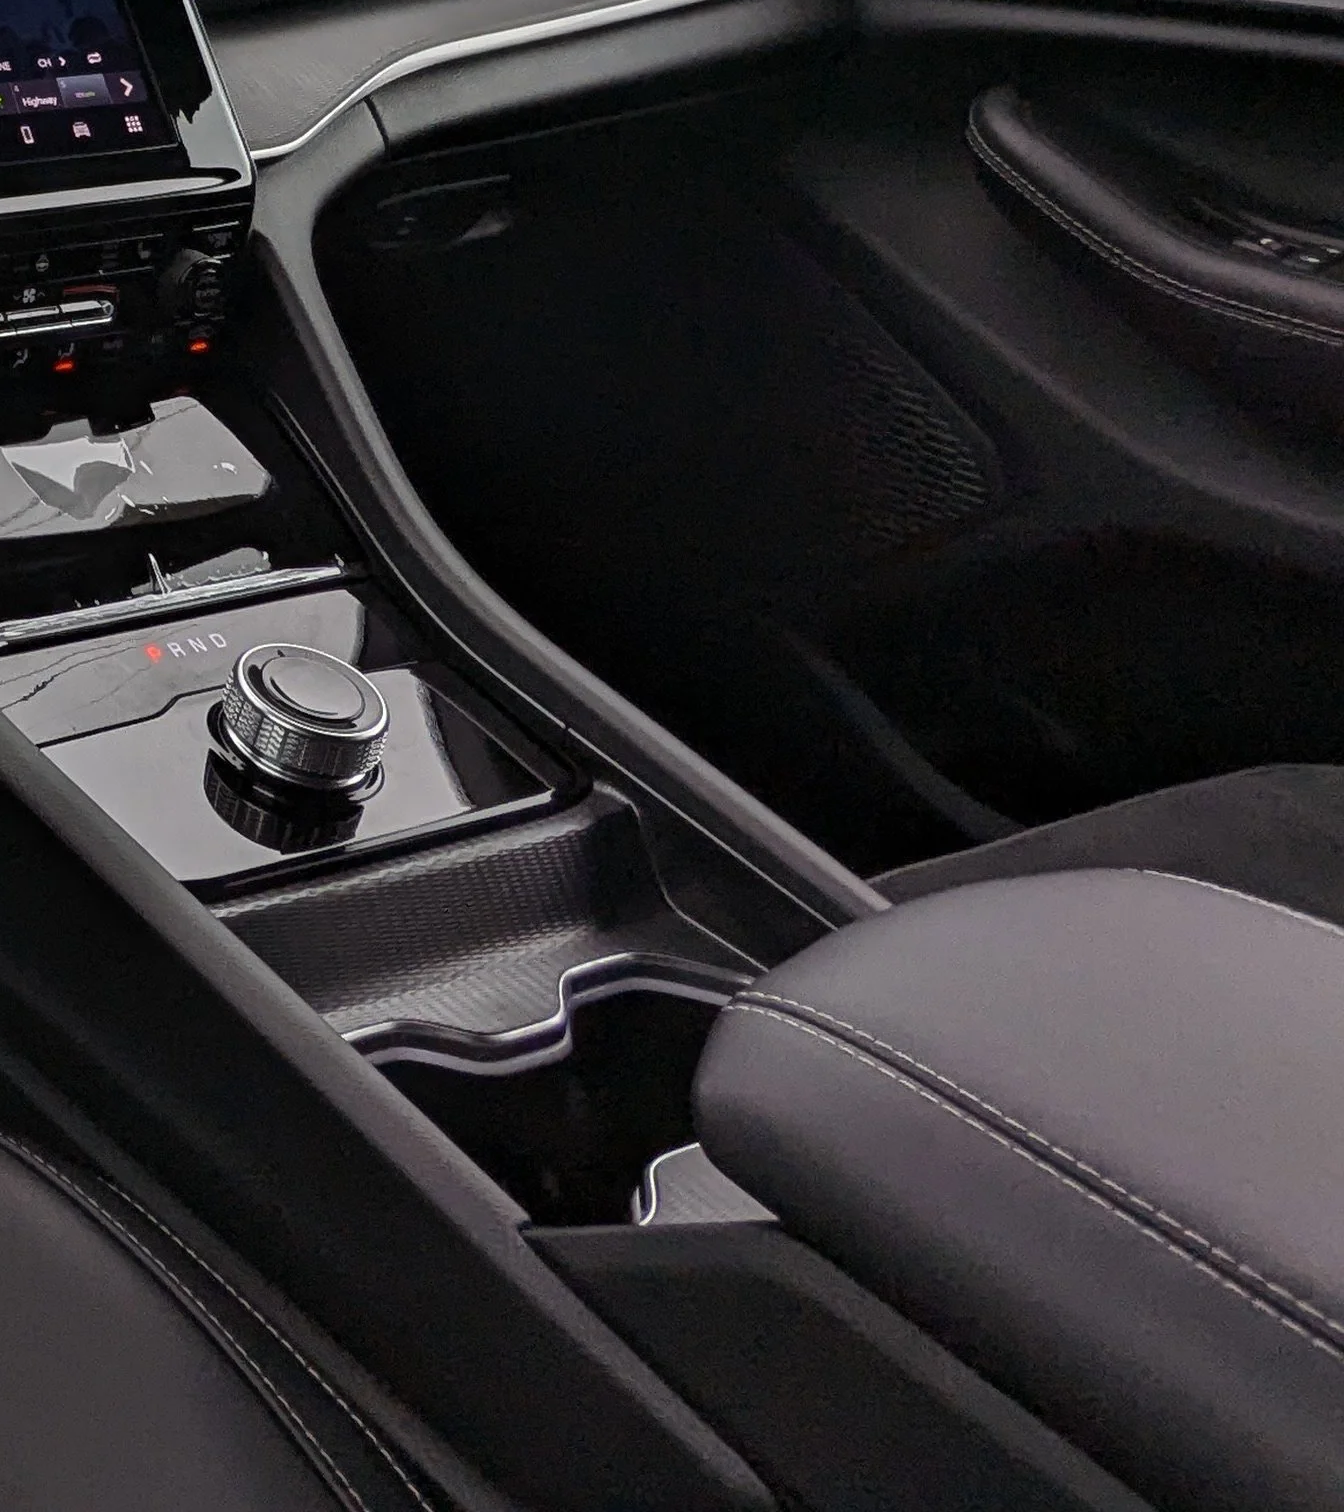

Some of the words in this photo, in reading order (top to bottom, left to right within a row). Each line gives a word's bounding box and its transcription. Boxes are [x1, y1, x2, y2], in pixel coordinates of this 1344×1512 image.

[37, 57, 52, 68] CH
[21, 95, 58, 108] Highway
[145, 645, 162, 664] P
[166, 641, 187, 658] R
[187, 637, 208, 653] N
[208, 633, 228, 649] D
